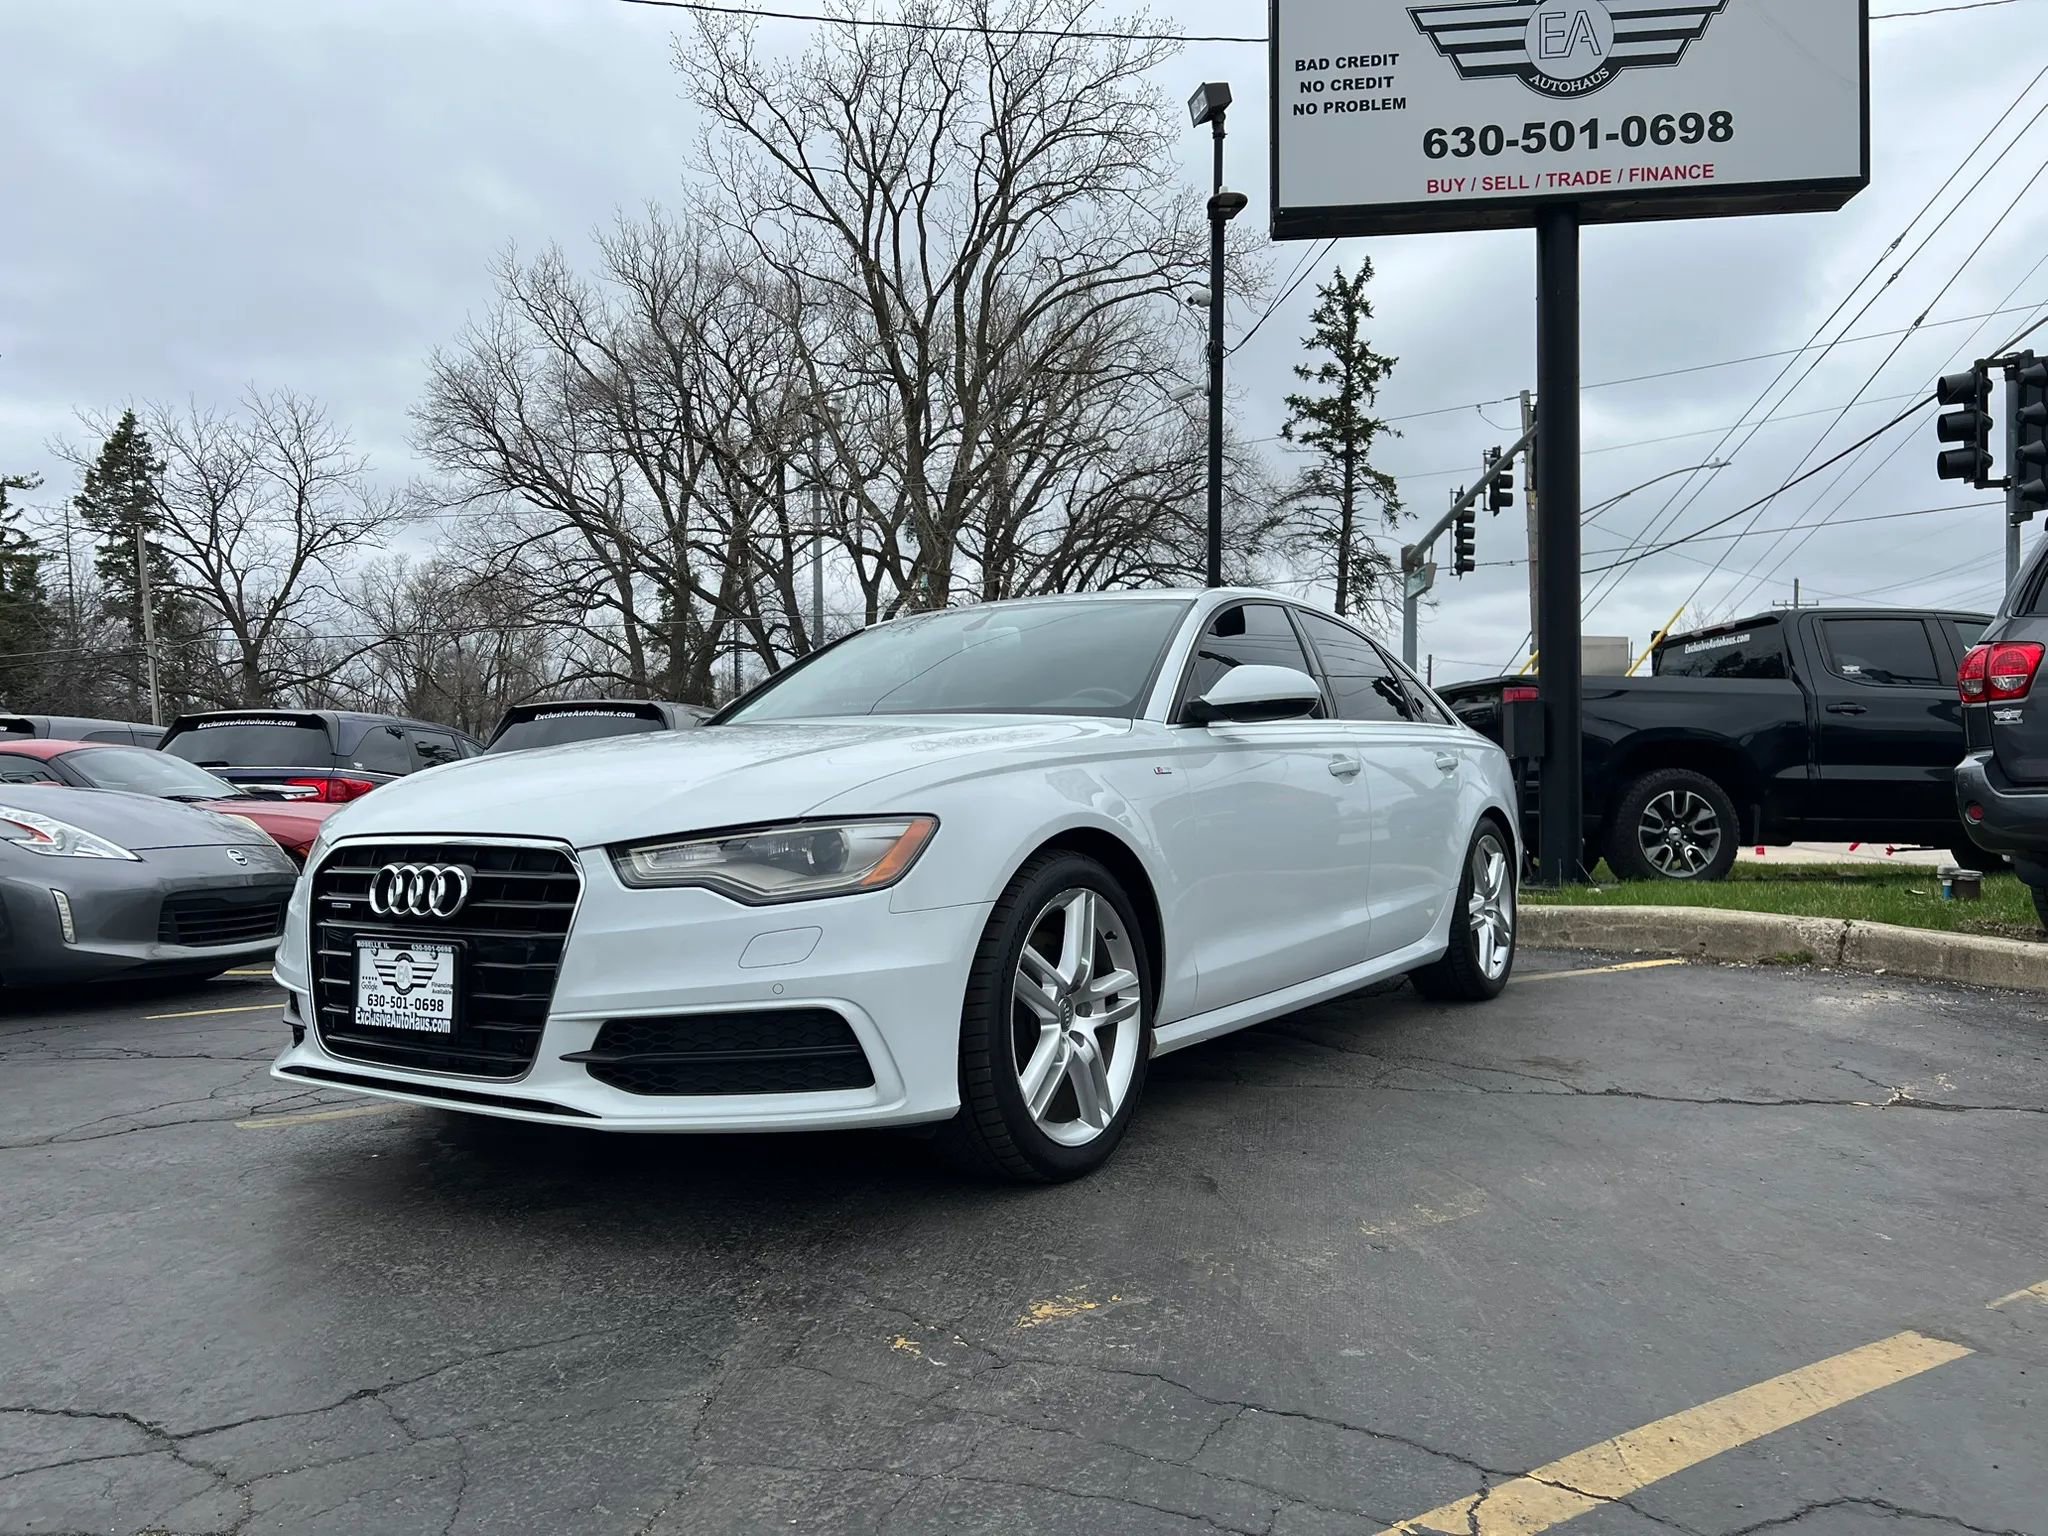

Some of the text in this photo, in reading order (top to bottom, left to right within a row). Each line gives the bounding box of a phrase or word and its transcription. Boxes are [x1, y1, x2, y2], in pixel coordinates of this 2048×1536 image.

[1539, 10, 1602, 59] EA
[1295, 53, 1400, 72] BAD CREDIT
[1300, 76, 1395, 94] NO CREDIT
[1529, 67, 1610, 92] AUTOHAUS
[1293, 97, 1407, 116] NO PROBLEM
[1422, 110, 1734, 160] 630-501-0698
[1426, 178, 1466, 194] BUY
[1482, 174, 1530, 191] SELL
[1546, 169, 1612, 187] TRADE
[1629, 163, 1715, 183] FINANCE
[361, 981, 378, 992] Google
[367, 994, 444, 1012] 630-501-0698
[355, 1007, 451, 1034] ExclusiveAutoHaus.com
